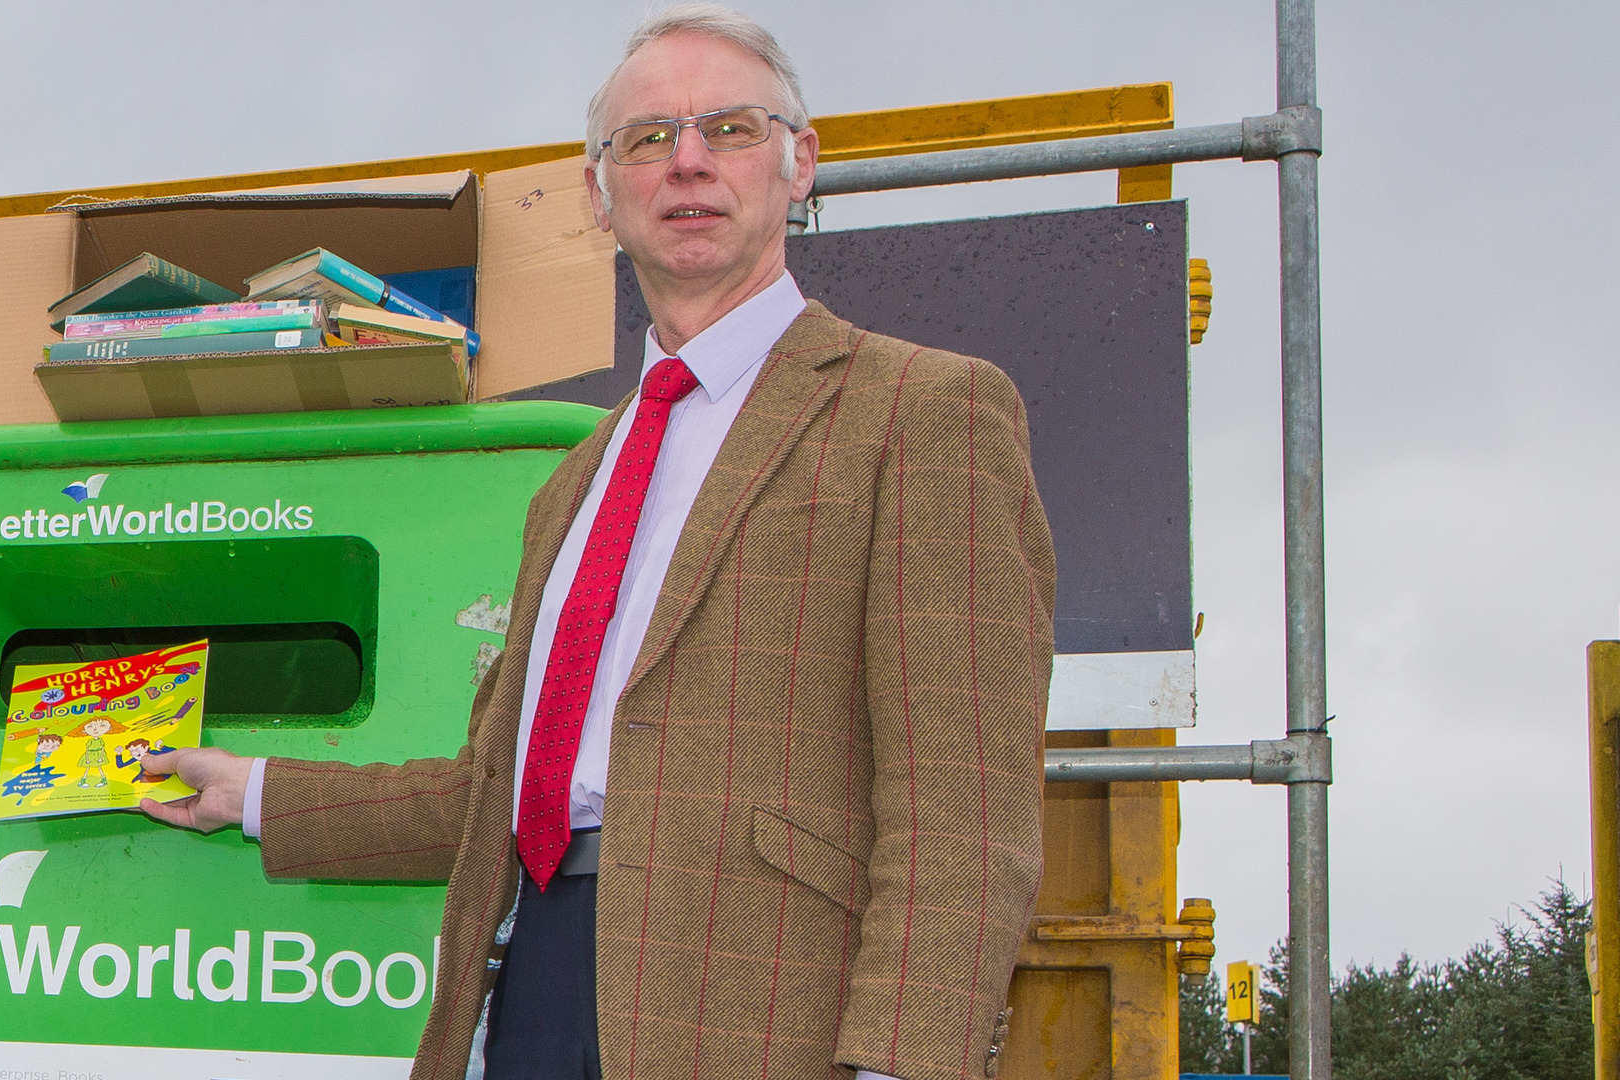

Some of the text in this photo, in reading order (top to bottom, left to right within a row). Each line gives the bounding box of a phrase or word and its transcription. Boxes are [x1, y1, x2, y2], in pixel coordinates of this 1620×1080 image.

[160, 306, 192, 316] Garden
[10, 663, 202, 724] Colouring Book
[70, 663, 166, 697] HENRY'S
[1229, 980, 1248, 1000] 12
